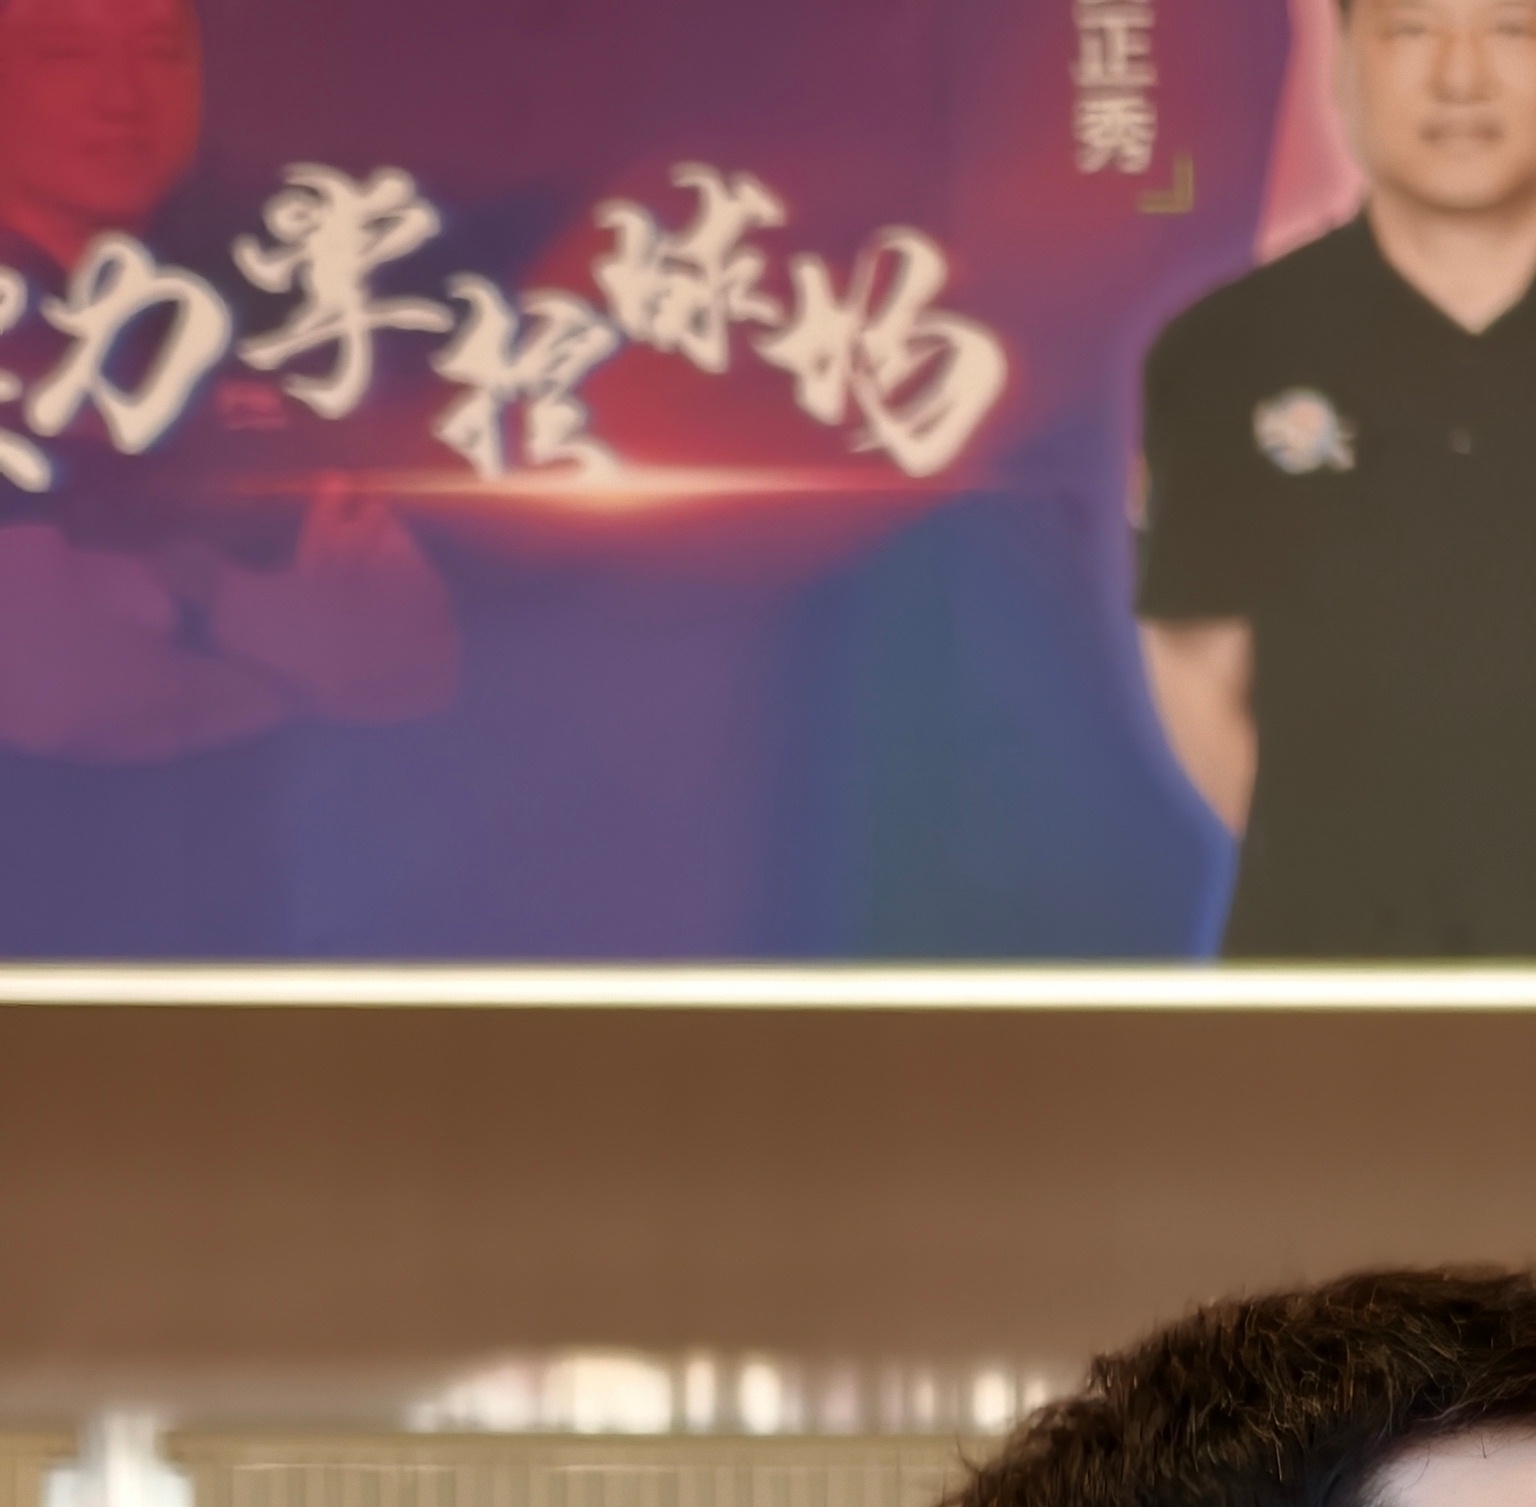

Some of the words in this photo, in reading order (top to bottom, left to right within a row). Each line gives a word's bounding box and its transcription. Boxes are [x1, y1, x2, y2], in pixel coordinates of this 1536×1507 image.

[1068, 0, 1158, 175] 正秀
[0, 163, 1006, 493] 力掌控球场
